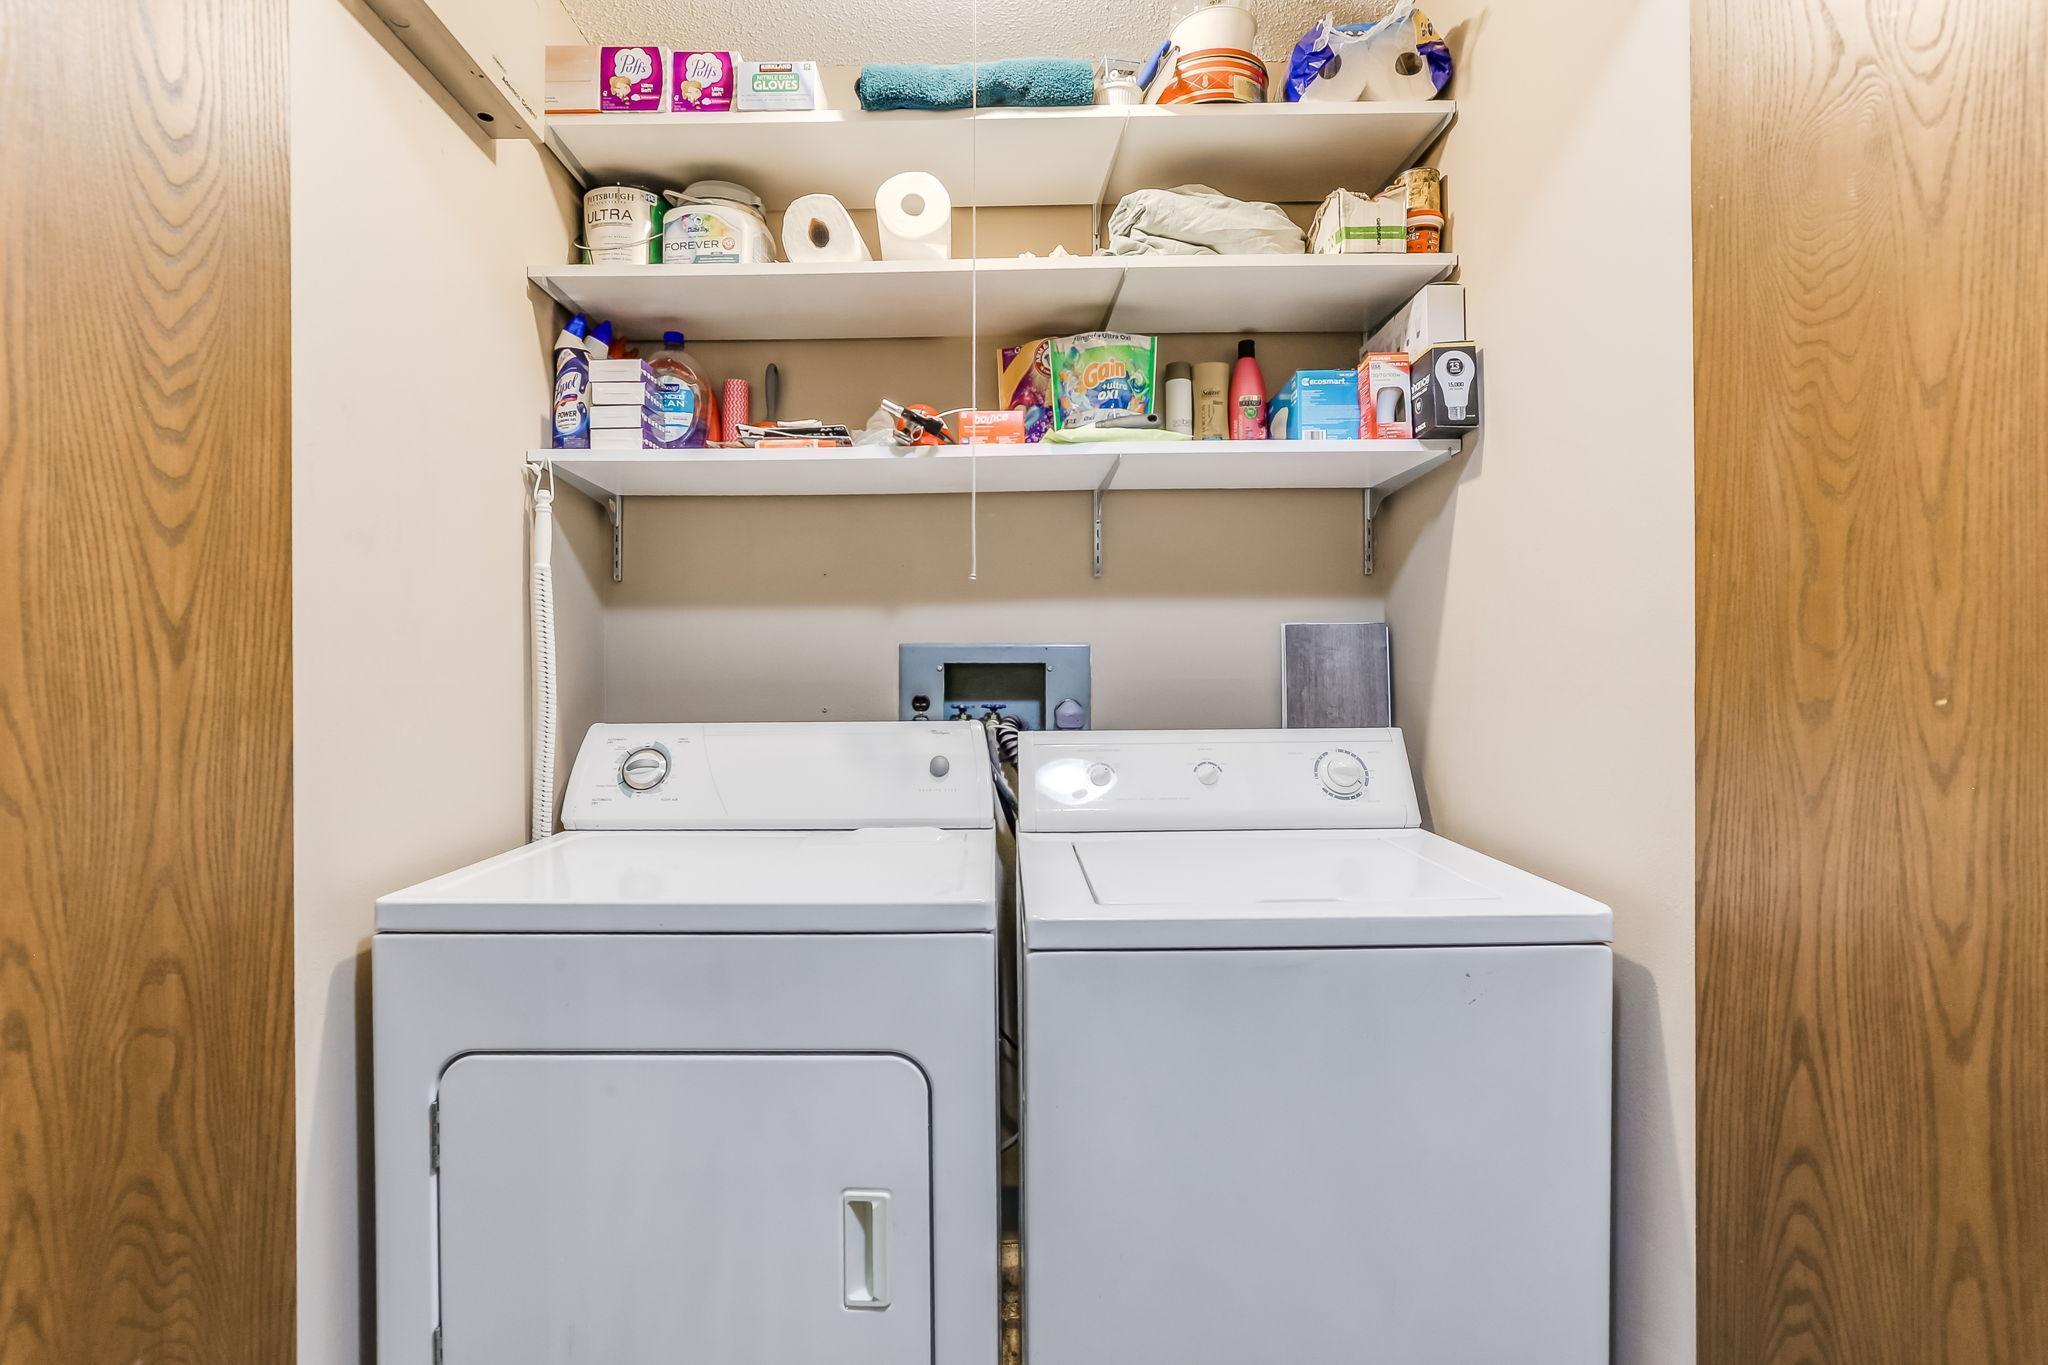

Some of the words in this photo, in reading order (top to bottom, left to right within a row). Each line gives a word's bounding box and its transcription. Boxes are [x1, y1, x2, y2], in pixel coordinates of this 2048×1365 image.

[620, 55, 647, 75] Puffs
[691, 59, 717, 78] Puffs
[753, 80, 798, 90] GLOVES
[586, 192, 635, 205] PITTSBURGH
[587, 208, 633, 224] ULTRA
[664, 239, 720, 252] FOREVER
[1449, 362, 1460, 370] 13
[1083, 361, 1126, 389] Gain
[557, 411, 577, 419] POWER
